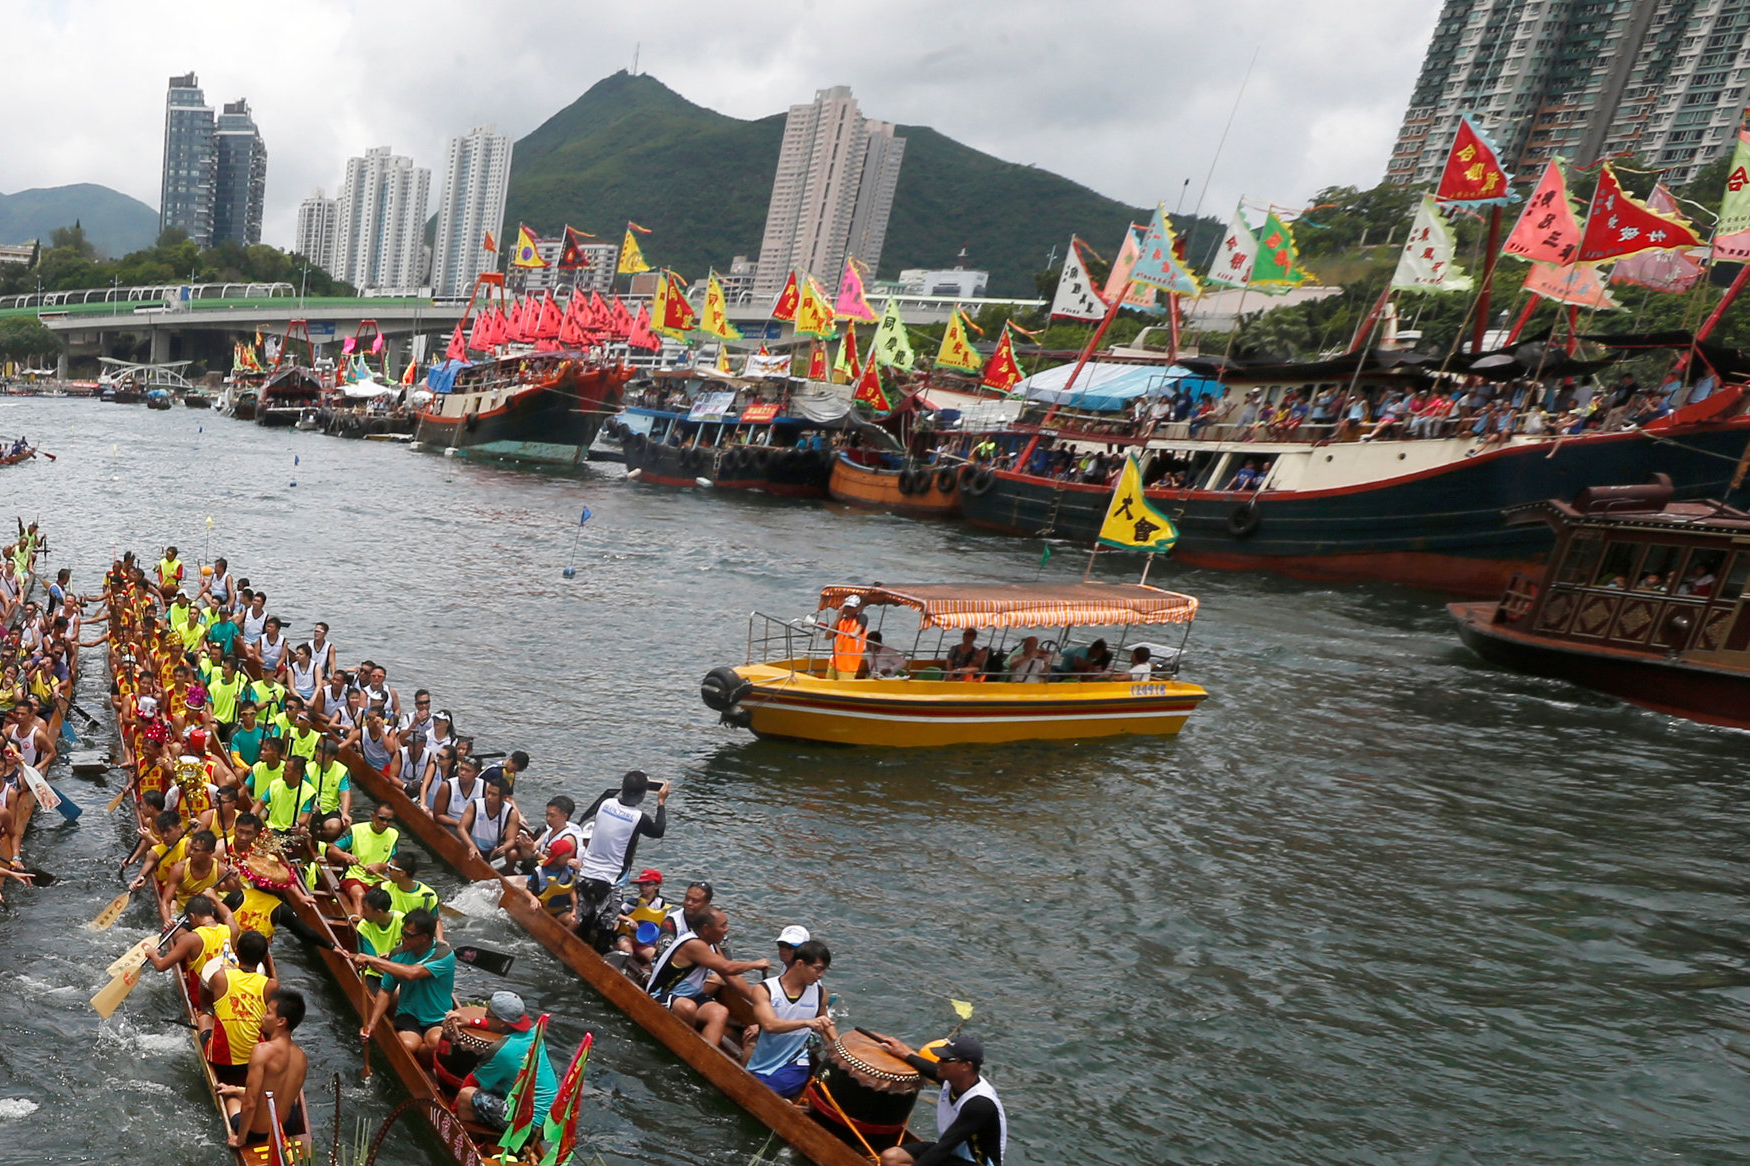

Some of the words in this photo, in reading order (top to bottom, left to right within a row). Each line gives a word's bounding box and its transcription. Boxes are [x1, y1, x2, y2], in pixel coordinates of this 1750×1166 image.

[882, 315, 907, 366] 同慶龍
[1113, 491, 1161, 543] 大會
